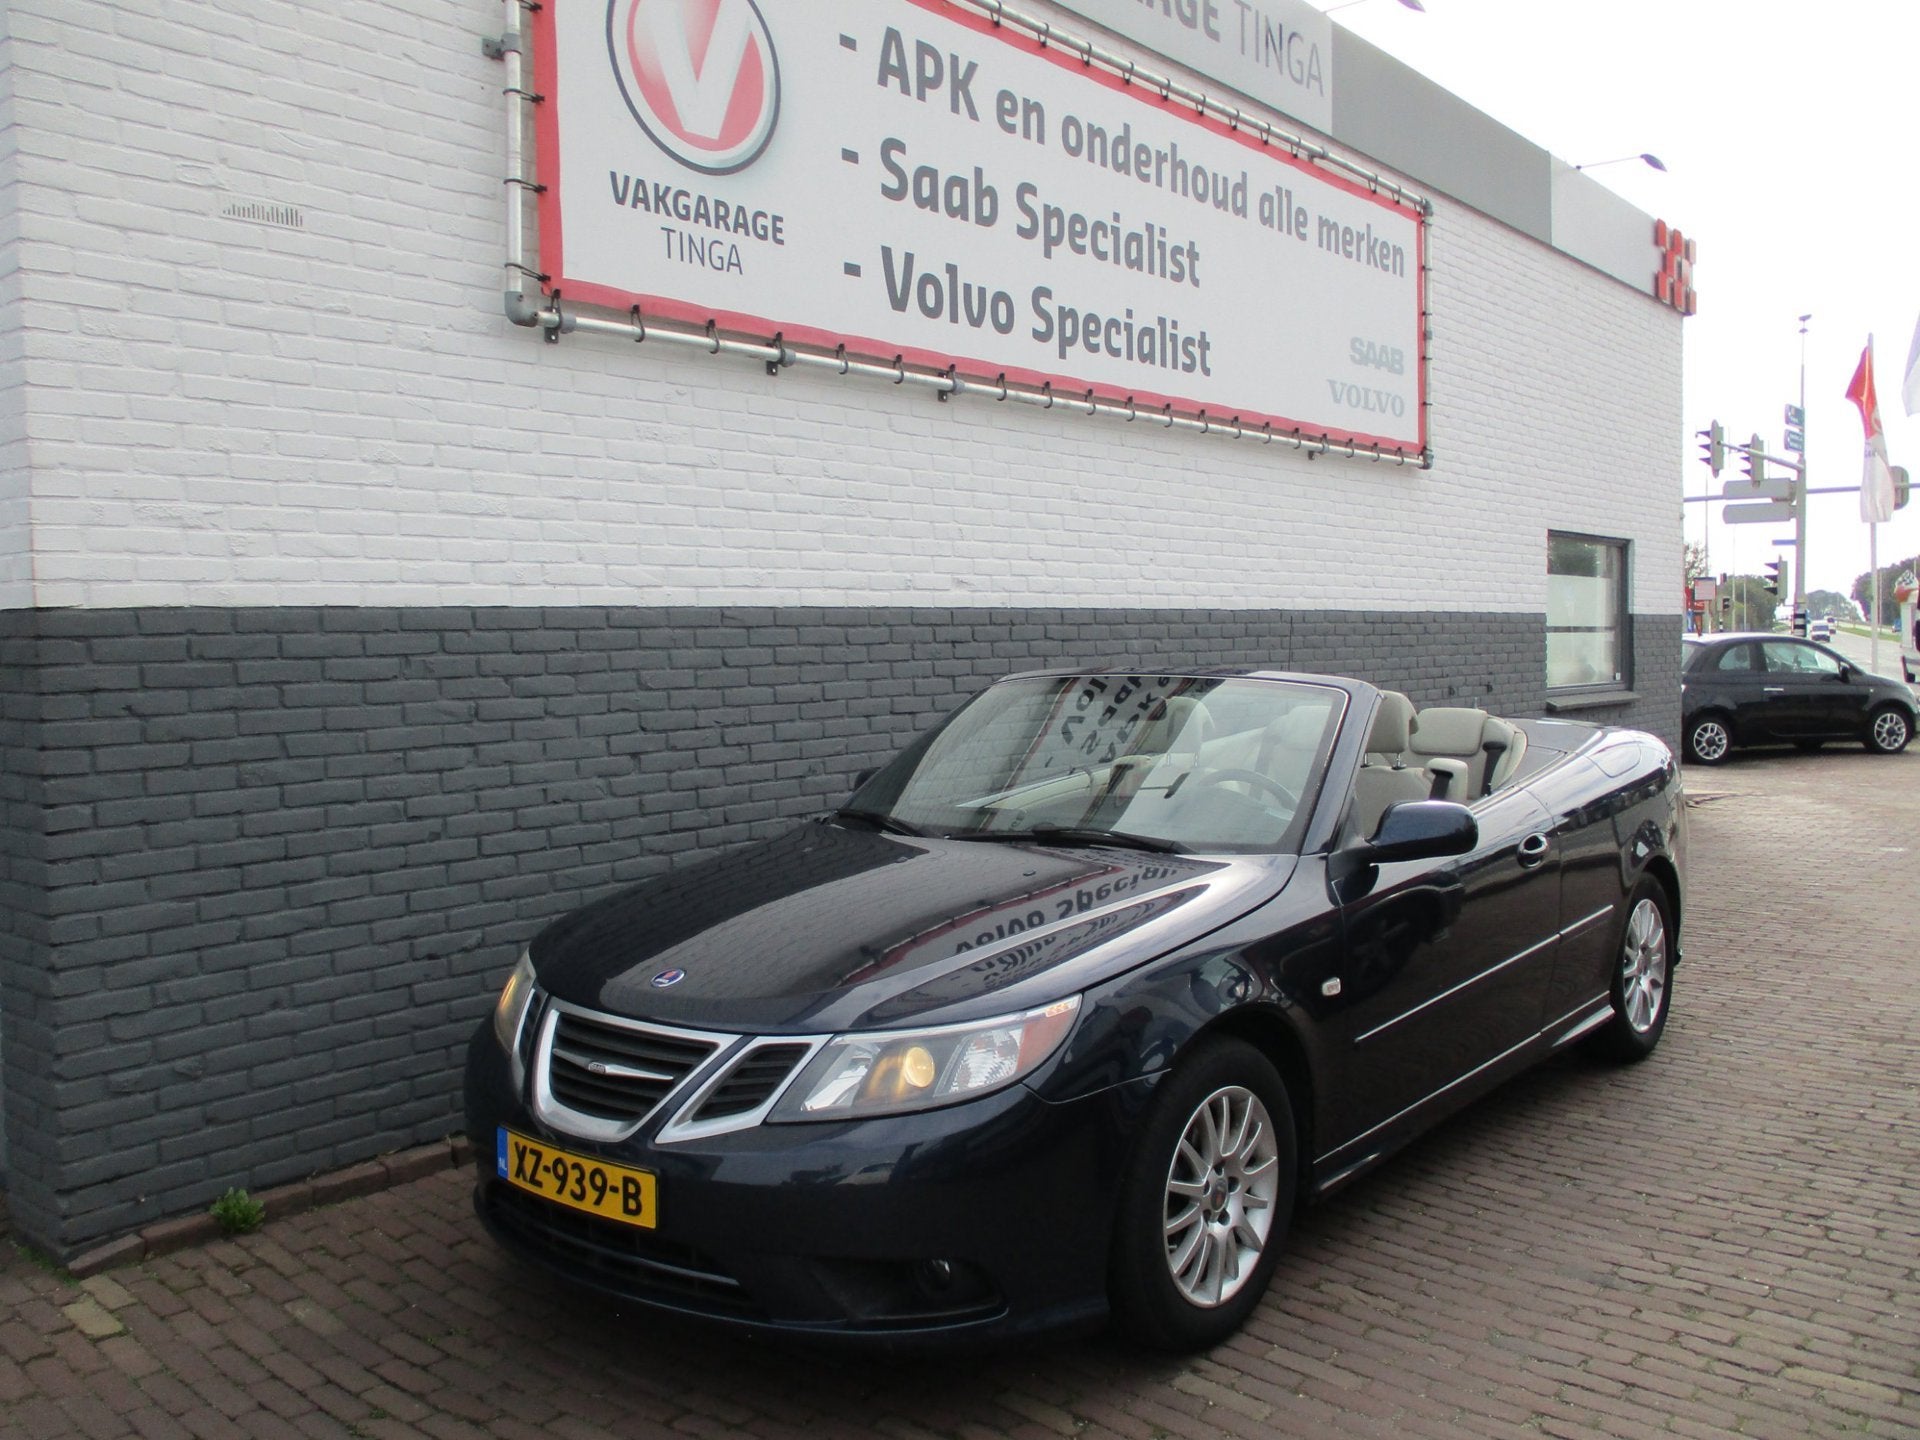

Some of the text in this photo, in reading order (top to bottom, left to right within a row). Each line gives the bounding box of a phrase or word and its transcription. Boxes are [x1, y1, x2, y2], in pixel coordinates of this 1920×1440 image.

[1233, 0, 1324, 97] TINGA
[877, 26, 980, 122] APK
[996, 89, 1045, 145] en
[1061, 114, 1248, 219] onderhoud
[1259, 186, 1308, 241] alle
[1317, 214, 1405, 278] merken
[609, 171, 785, 246] VAKGARAGE
[880, 137, 999, 228] Saab
[1016, 181, 1200, 288] Specialist
[660, 226, 744, 276] TINGA
[880, 245, 1015, 335] Volvo
[1031, 285, 1211, 377] Specialist
[1349, 336, 1405, 376] SAAB
[1326, 379, 1405, 418] VOLVO
[514, 1141, 643, 1217] XZ-939-B
